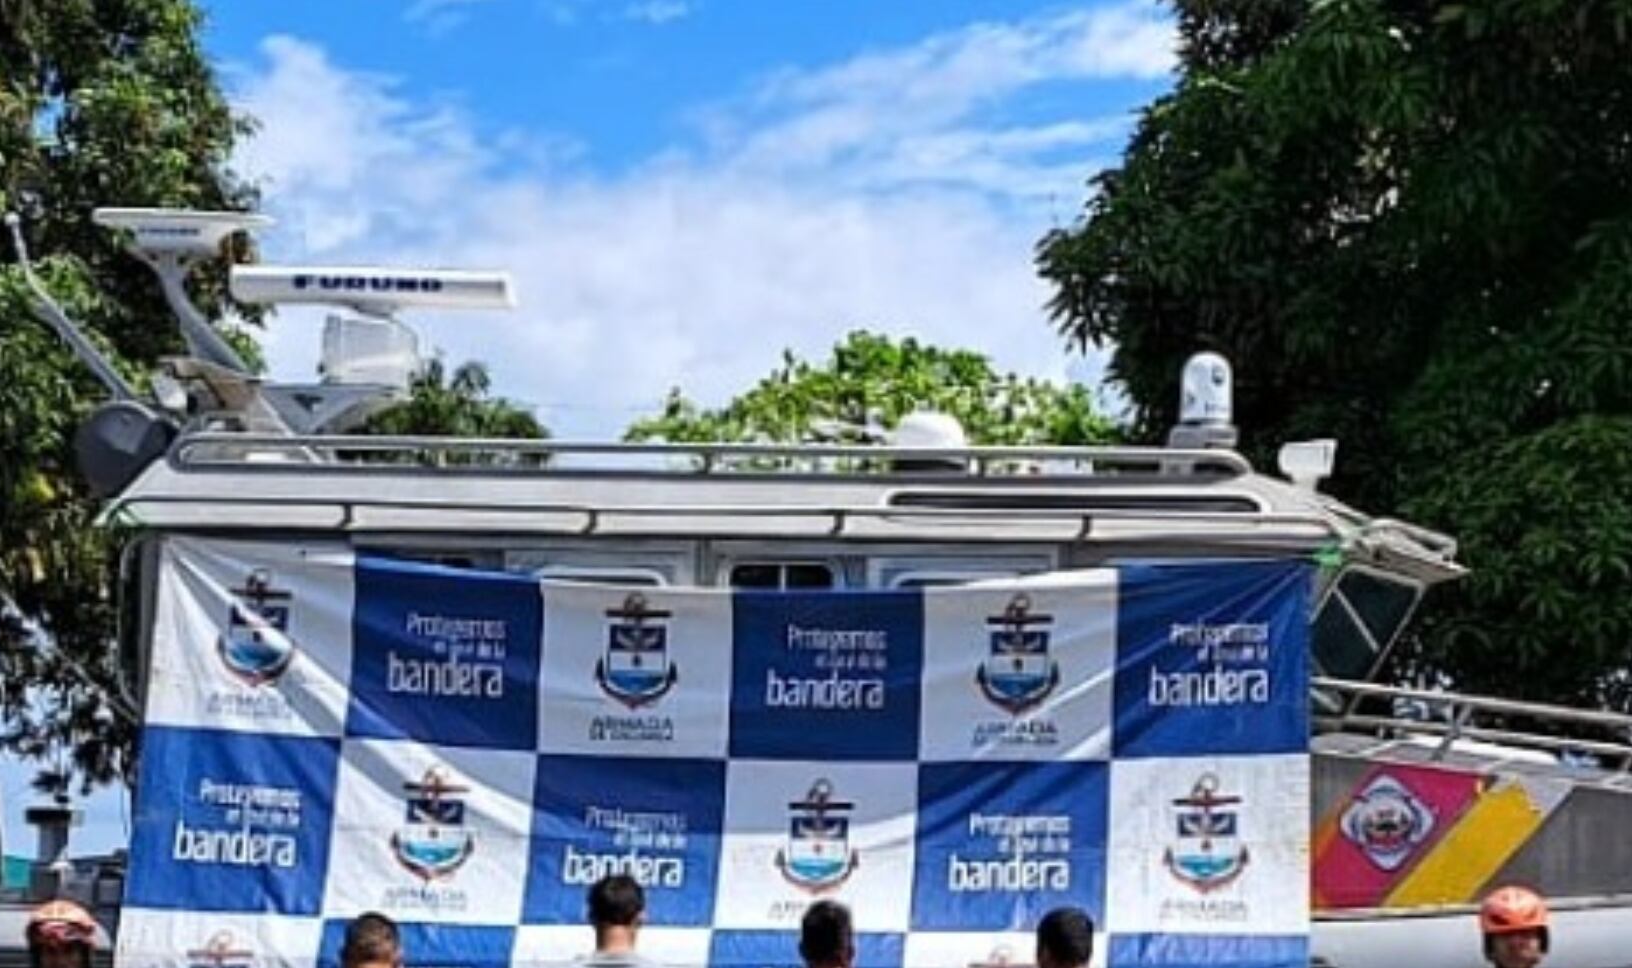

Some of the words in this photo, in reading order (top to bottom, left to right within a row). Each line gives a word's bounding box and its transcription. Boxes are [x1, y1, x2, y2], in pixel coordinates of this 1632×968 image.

[293, 274, 444, 292] FURUNO
[387, 651, 503, 698] bandera
[767, 668, 884, 709] bandera
[1148, 664, 1269, 706] bandera
[172, 819, 296, 868] bandera
[948, 850, 1069, 892] bandera
